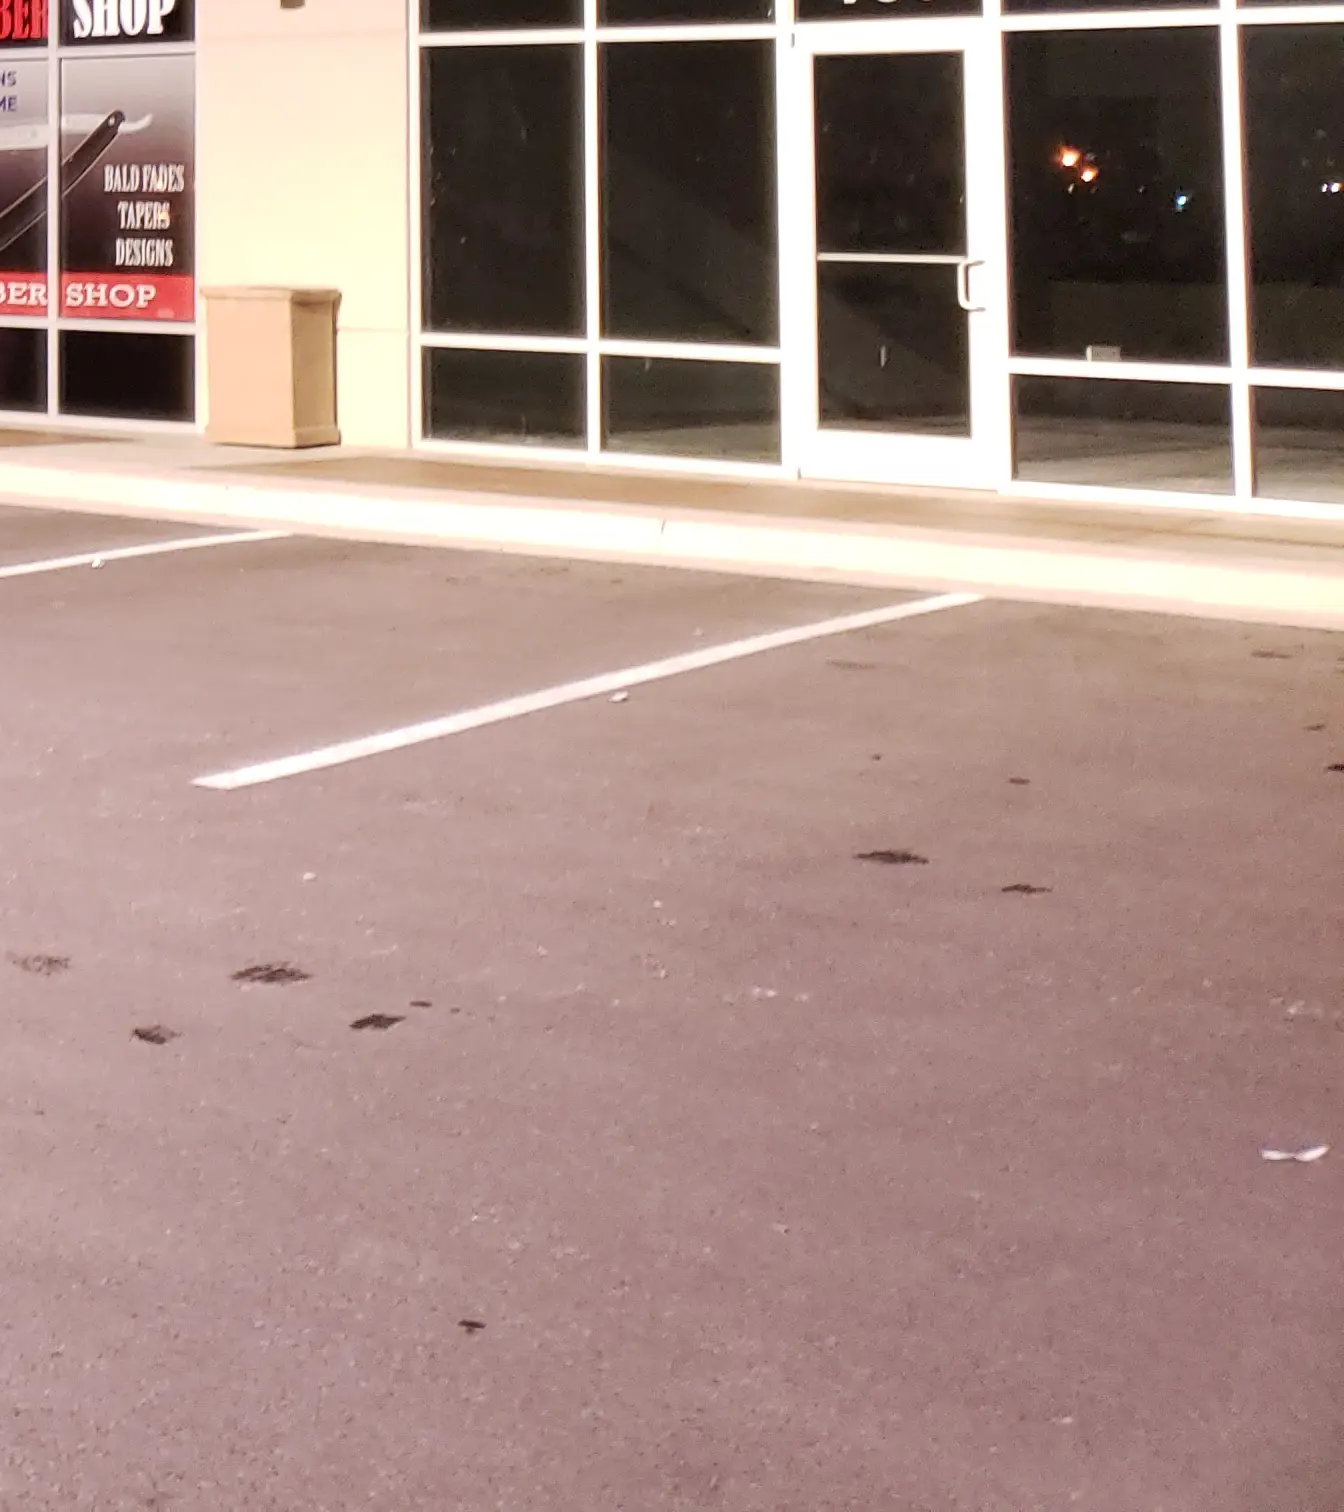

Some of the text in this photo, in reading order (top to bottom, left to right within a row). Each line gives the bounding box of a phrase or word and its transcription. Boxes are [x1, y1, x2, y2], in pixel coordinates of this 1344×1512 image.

[104, 163, 185, 193] BALD FADES
[117, 201, 170, 230] TAPERS
[115, 238, 174, 266] DESIGNS
[65, 282, 156, 309] SHOP
